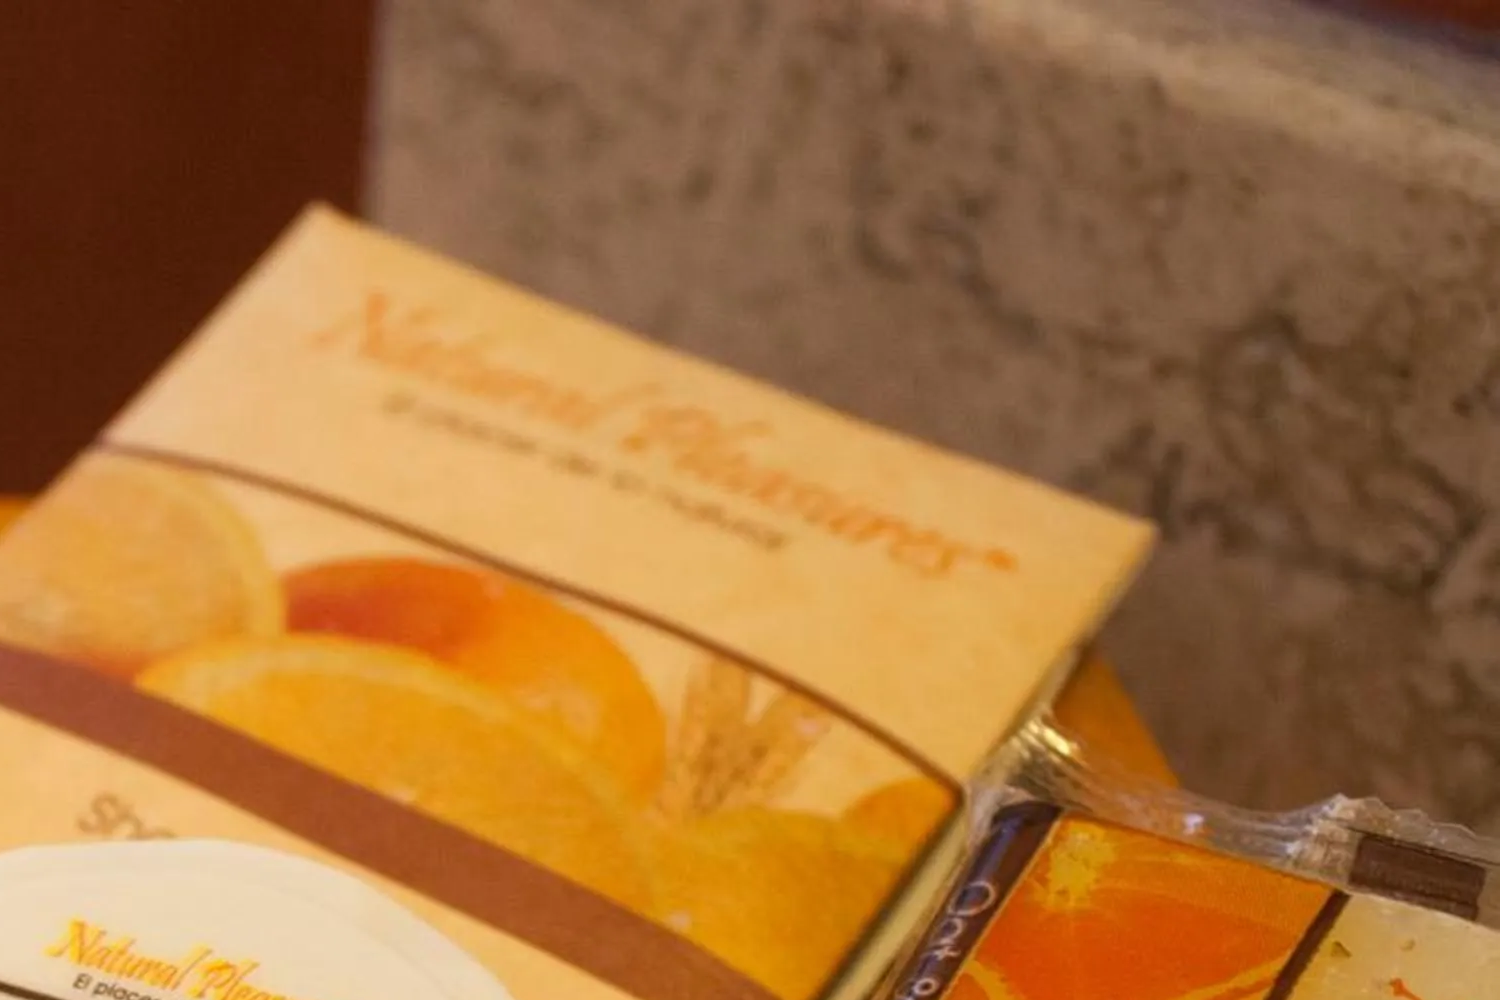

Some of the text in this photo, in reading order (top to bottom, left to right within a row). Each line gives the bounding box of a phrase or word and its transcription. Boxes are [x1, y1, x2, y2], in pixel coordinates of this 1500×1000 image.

[76, 790, 178, 839] Sh
[44, 918, 213, 992] Natural
[72, 972, 92, 991] El
